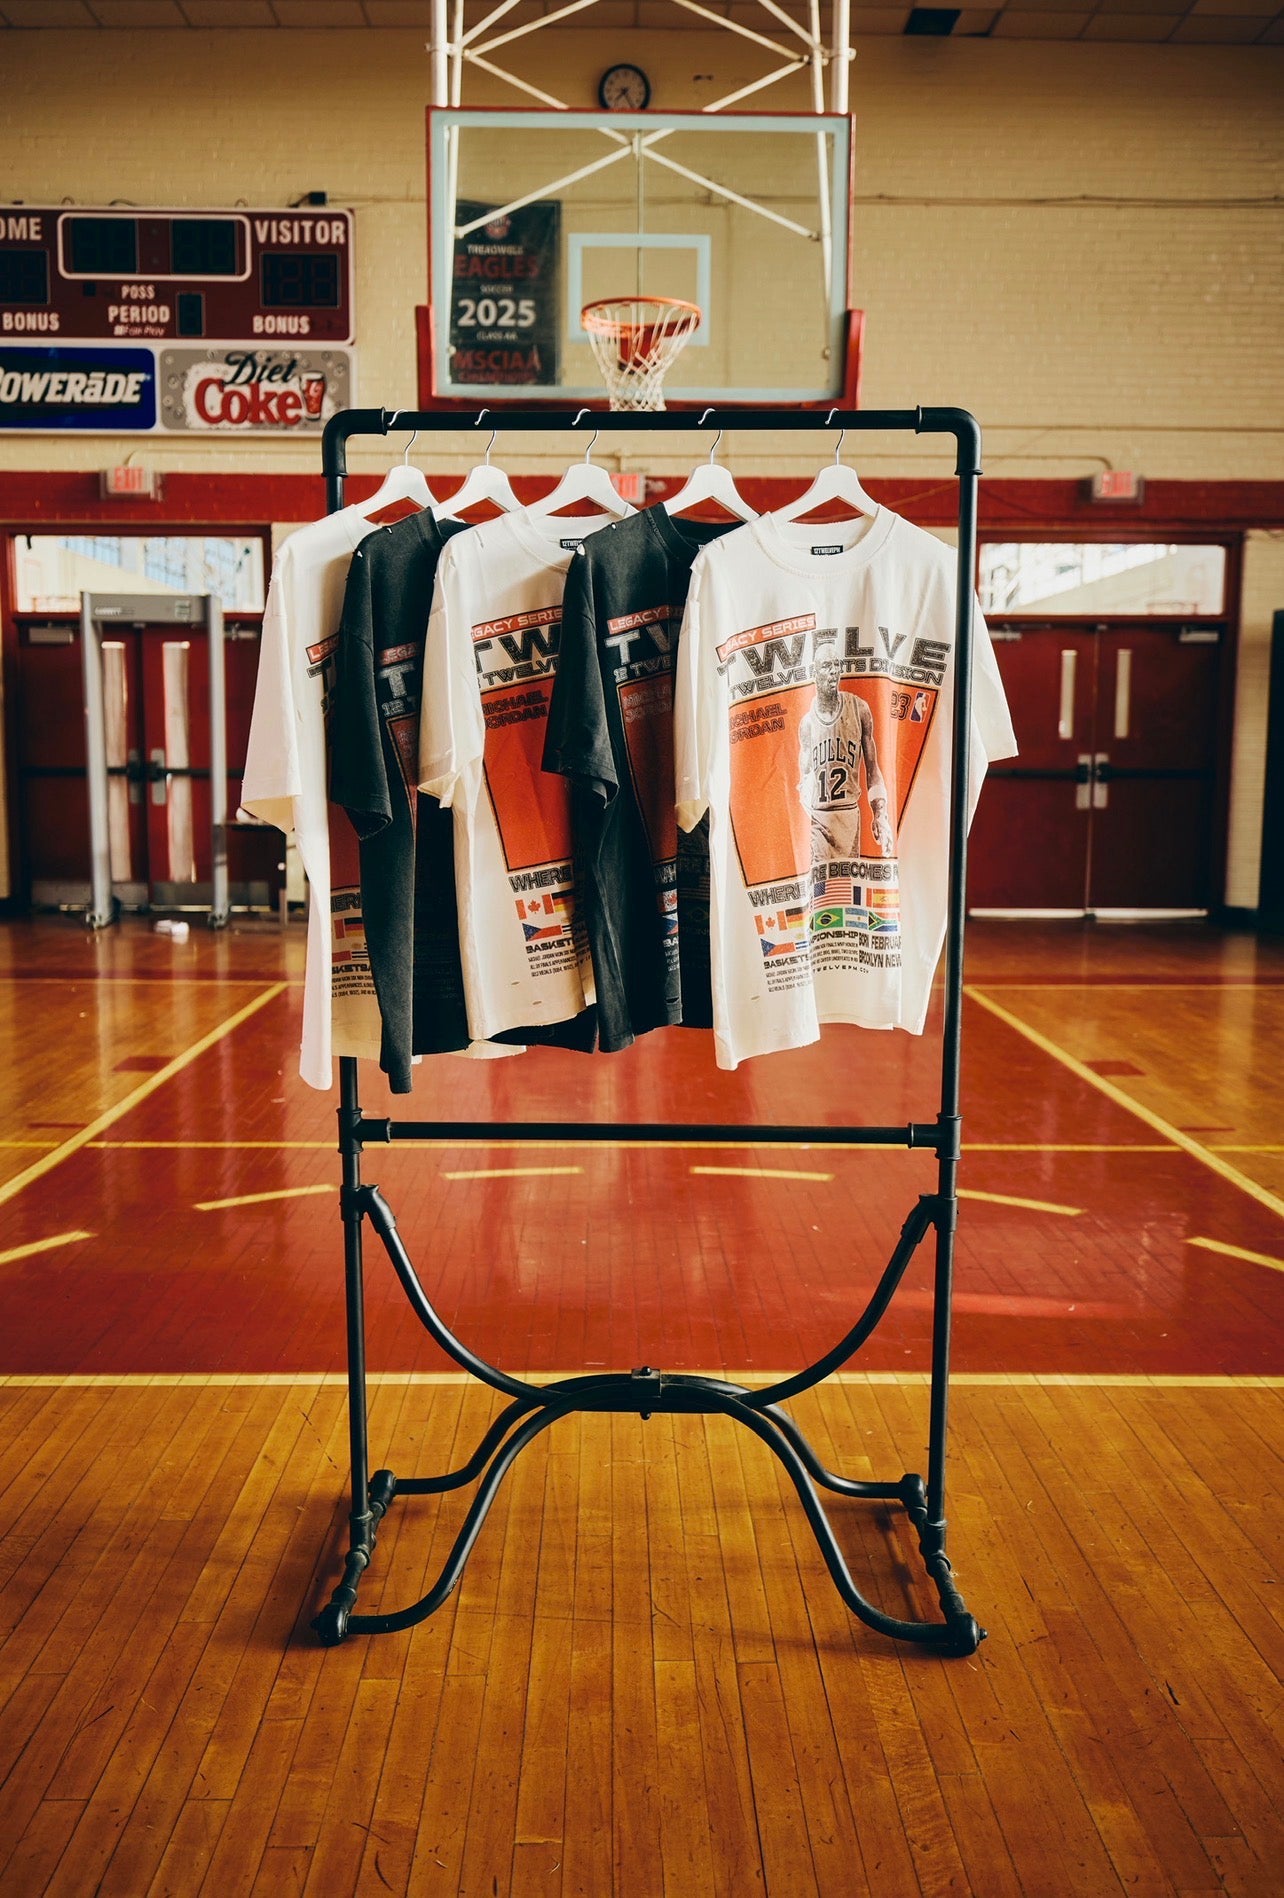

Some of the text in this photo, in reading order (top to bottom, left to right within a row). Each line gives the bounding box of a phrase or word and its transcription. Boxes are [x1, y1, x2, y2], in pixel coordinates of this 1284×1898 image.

[0, 216, 42, 240] OME
[255, 219, 346, 244] VISITOR
[455, 255, 539, 278] EAGLES
[121, 284, 155, 299] POSS
[2, 311, 60, 332] BONUS
[108, 304, 170, 323] PERIOD
[253, 314, 310, 334] BONUS
[457, 298, 536, 328] 2025
[224, 350, 299, 386] Diet
[194, 377, 302, 426] Coke
[518, 607, 562, 627] SERIE
[608, 607, 662, 631] LEGACY
[761, 615, 815, 638] SERIES
[730, 716, 786, 744] ORDAN
[812, 737, 857, 771] BULLS
[818, 766, 848, 803] 12
[508, 865, 572, 893] WHERE
[828, 861, 892, 882] BECOMES
[525, 937, 573, 954] BASKET
